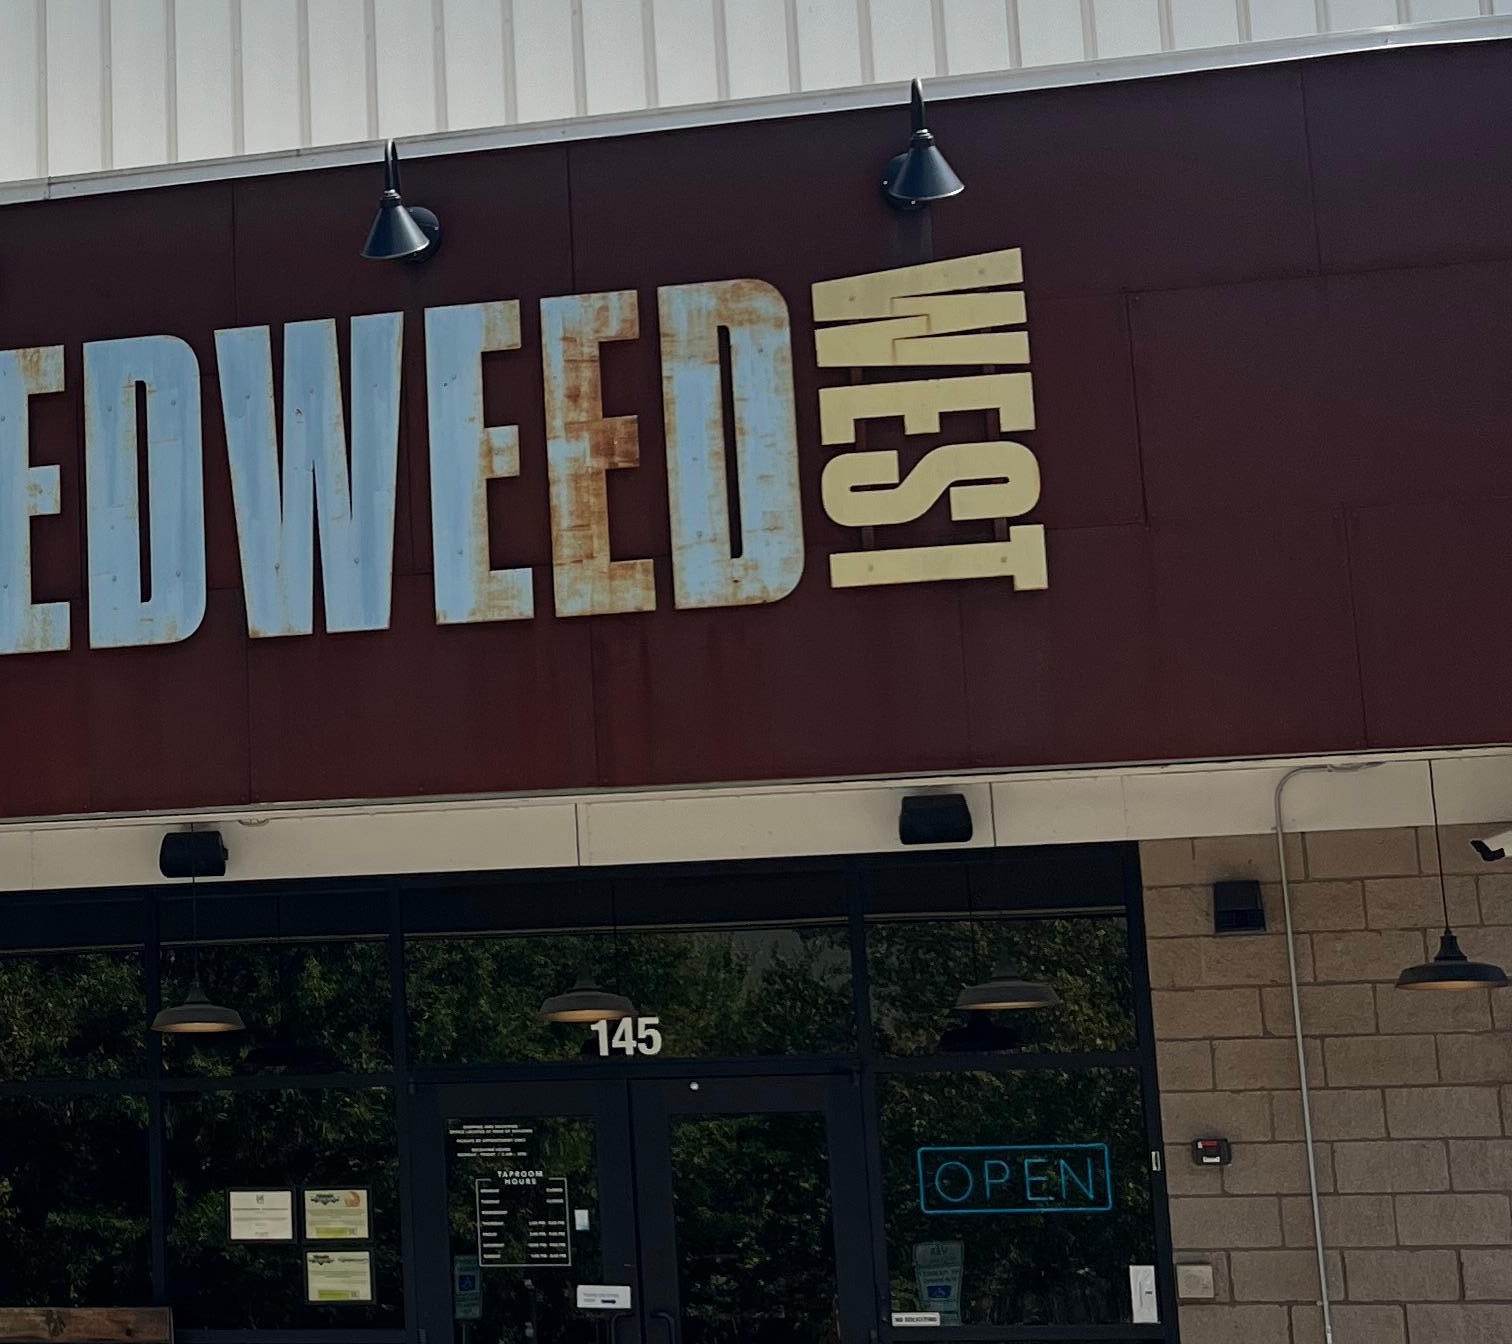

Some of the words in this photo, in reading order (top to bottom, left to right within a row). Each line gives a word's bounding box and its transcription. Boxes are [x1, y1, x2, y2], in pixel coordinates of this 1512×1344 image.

[811, 246, 1049, 592] WEST
[590, 1016, 662, 1056] 145
[933, 1157, 1095, 1203] OPEN
